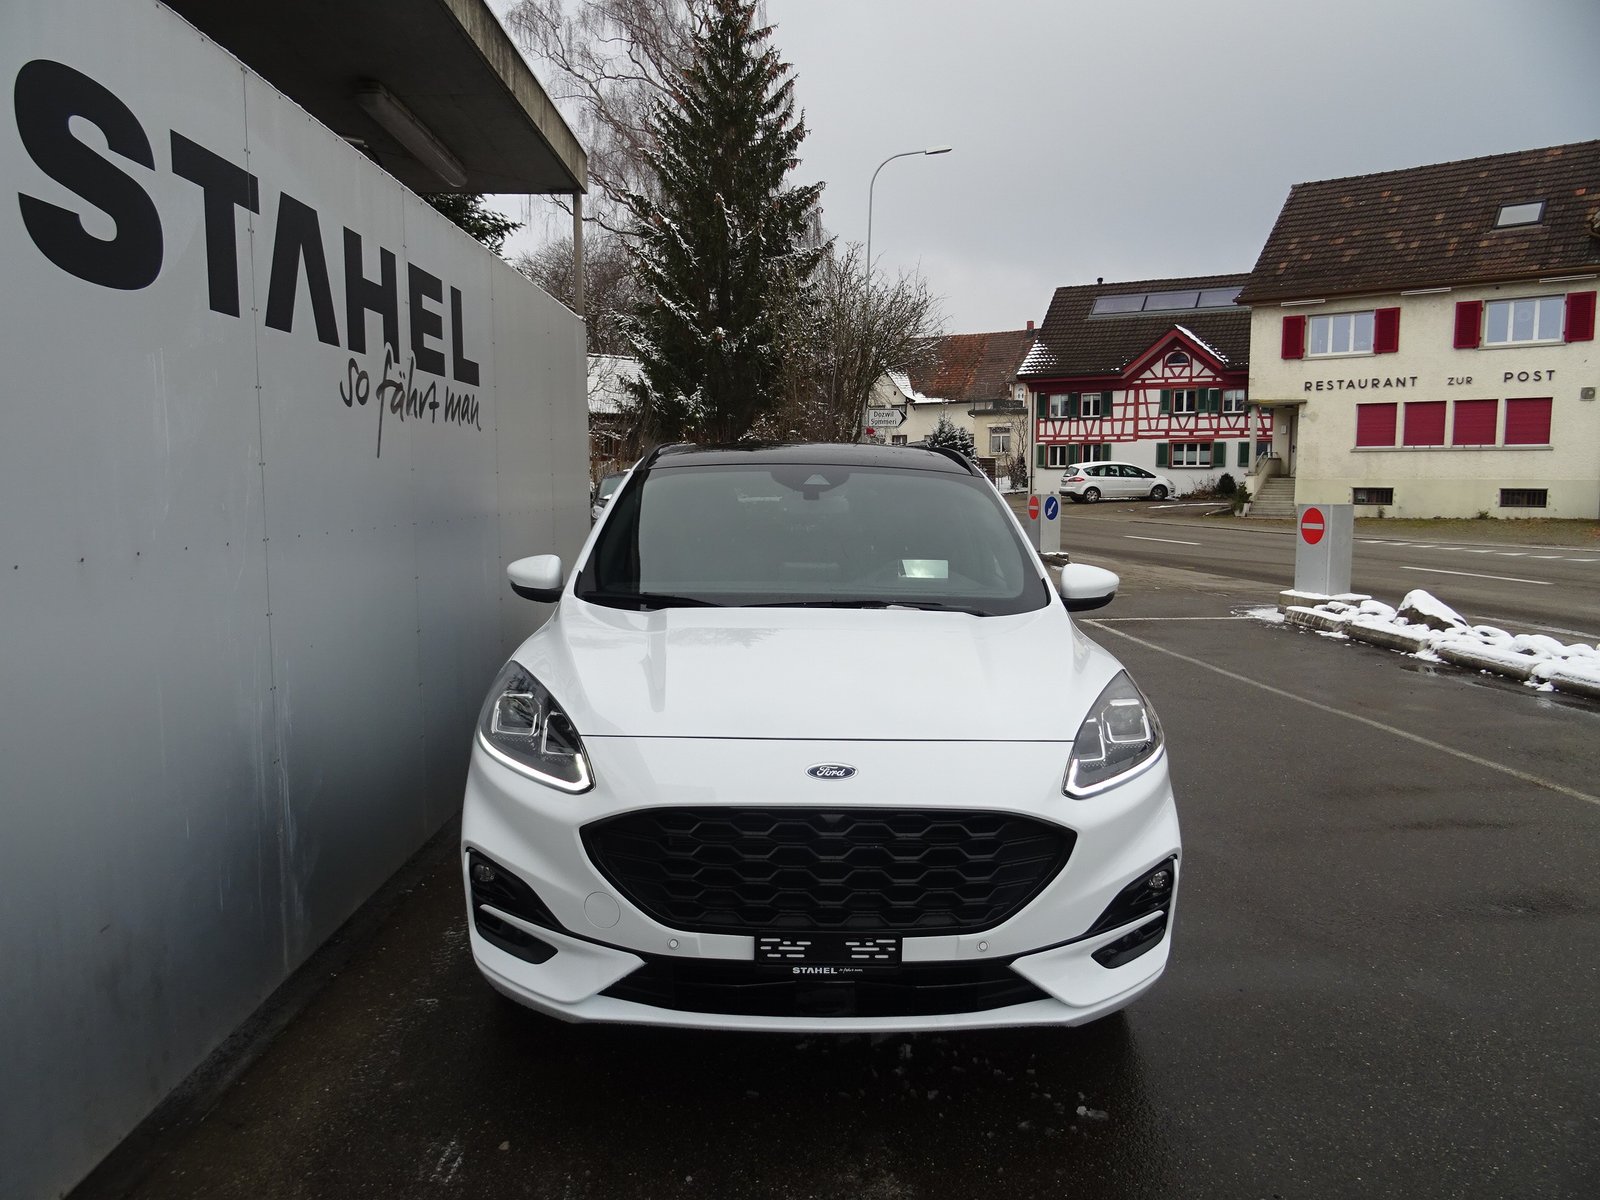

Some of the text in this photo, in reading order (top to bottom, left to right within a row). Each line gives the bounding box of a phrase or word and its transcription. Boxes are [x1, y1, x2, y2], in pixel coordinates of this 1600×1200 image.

[14, 59, 480, 387] STAHEL
[1304, 370, 1556, 392] RESTAURANT ZUR POST
[376, 342, 441, 458] fährt
[444, 386, 482, 431] man
[816, 766, 846, 776] Ford
[792, 966, 838, 974] STAHEL
